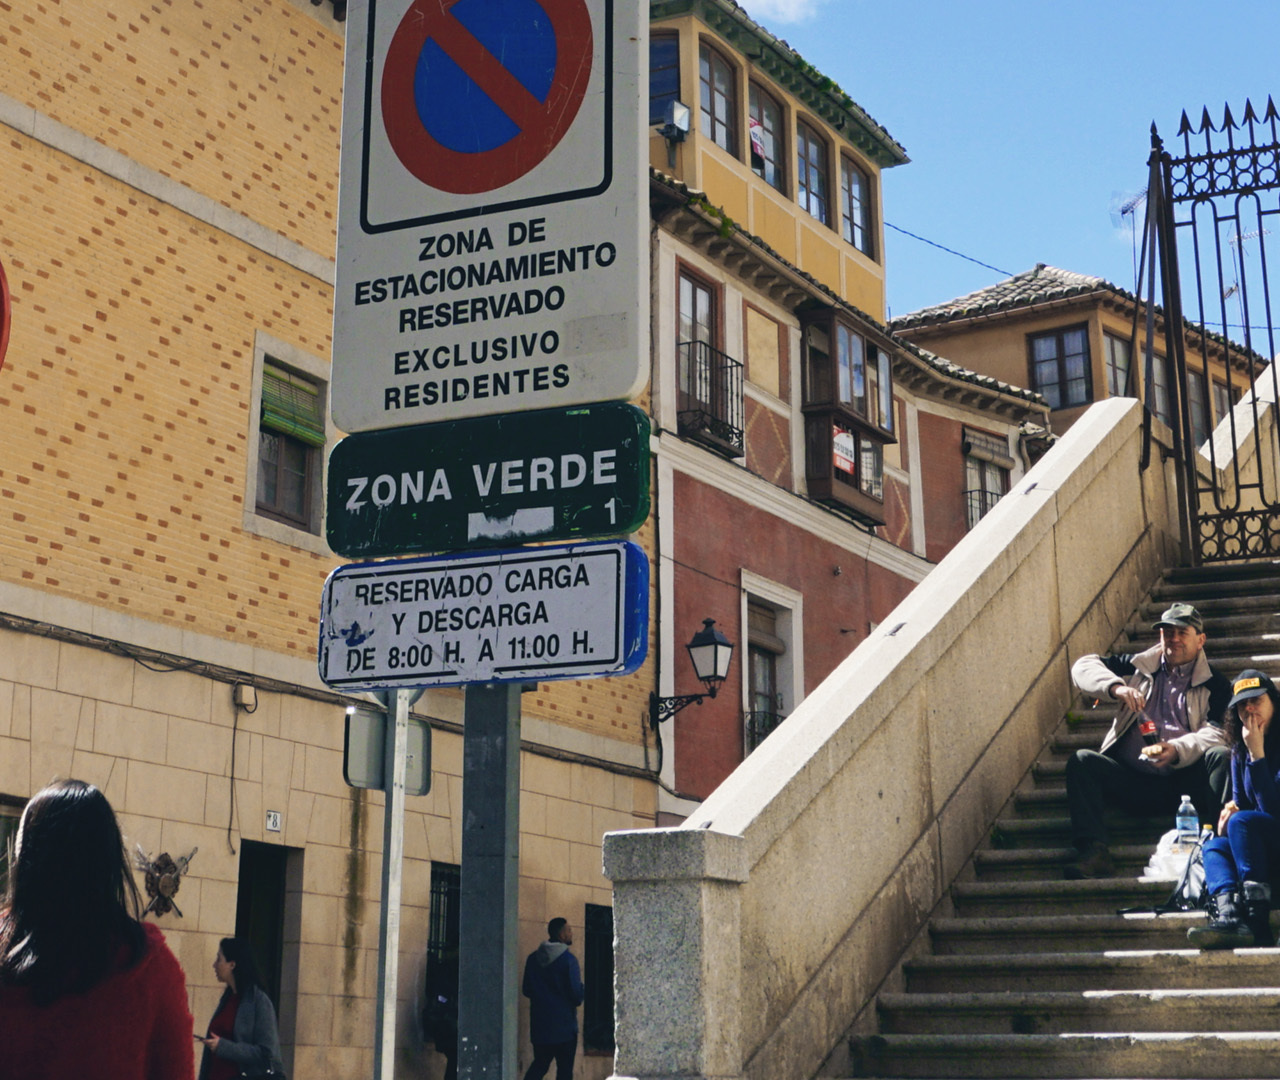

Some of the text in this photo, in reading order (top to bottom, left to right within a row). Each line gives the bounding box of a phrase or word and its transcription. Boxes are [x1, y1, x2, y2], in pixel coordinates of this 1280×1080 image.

[419, 217, 546, 262] ZONA DE
[354, 241, 616, 306] ESTACIONAMIENTO
[399, 285, 565, 333] RESERVADO
[394, 329, 560, 375] EXCLUSIVO
[384, 363, 570, 411] RESIDENTES
[345, 449, 617, 512] ZONA VERDE
[604, 497, 616, 525] 1
[355, 563, 590, 606] RESERVADO CARGA
[392, 601, 549, 635] Y DESCARGA
[347, 646, 376, 673] DE
[388, 643, 433, 669] 8:00
[444, 641, 465, 665] H.
[478, 639, 494, 662] A
[572, 631, 594, 655] H.
